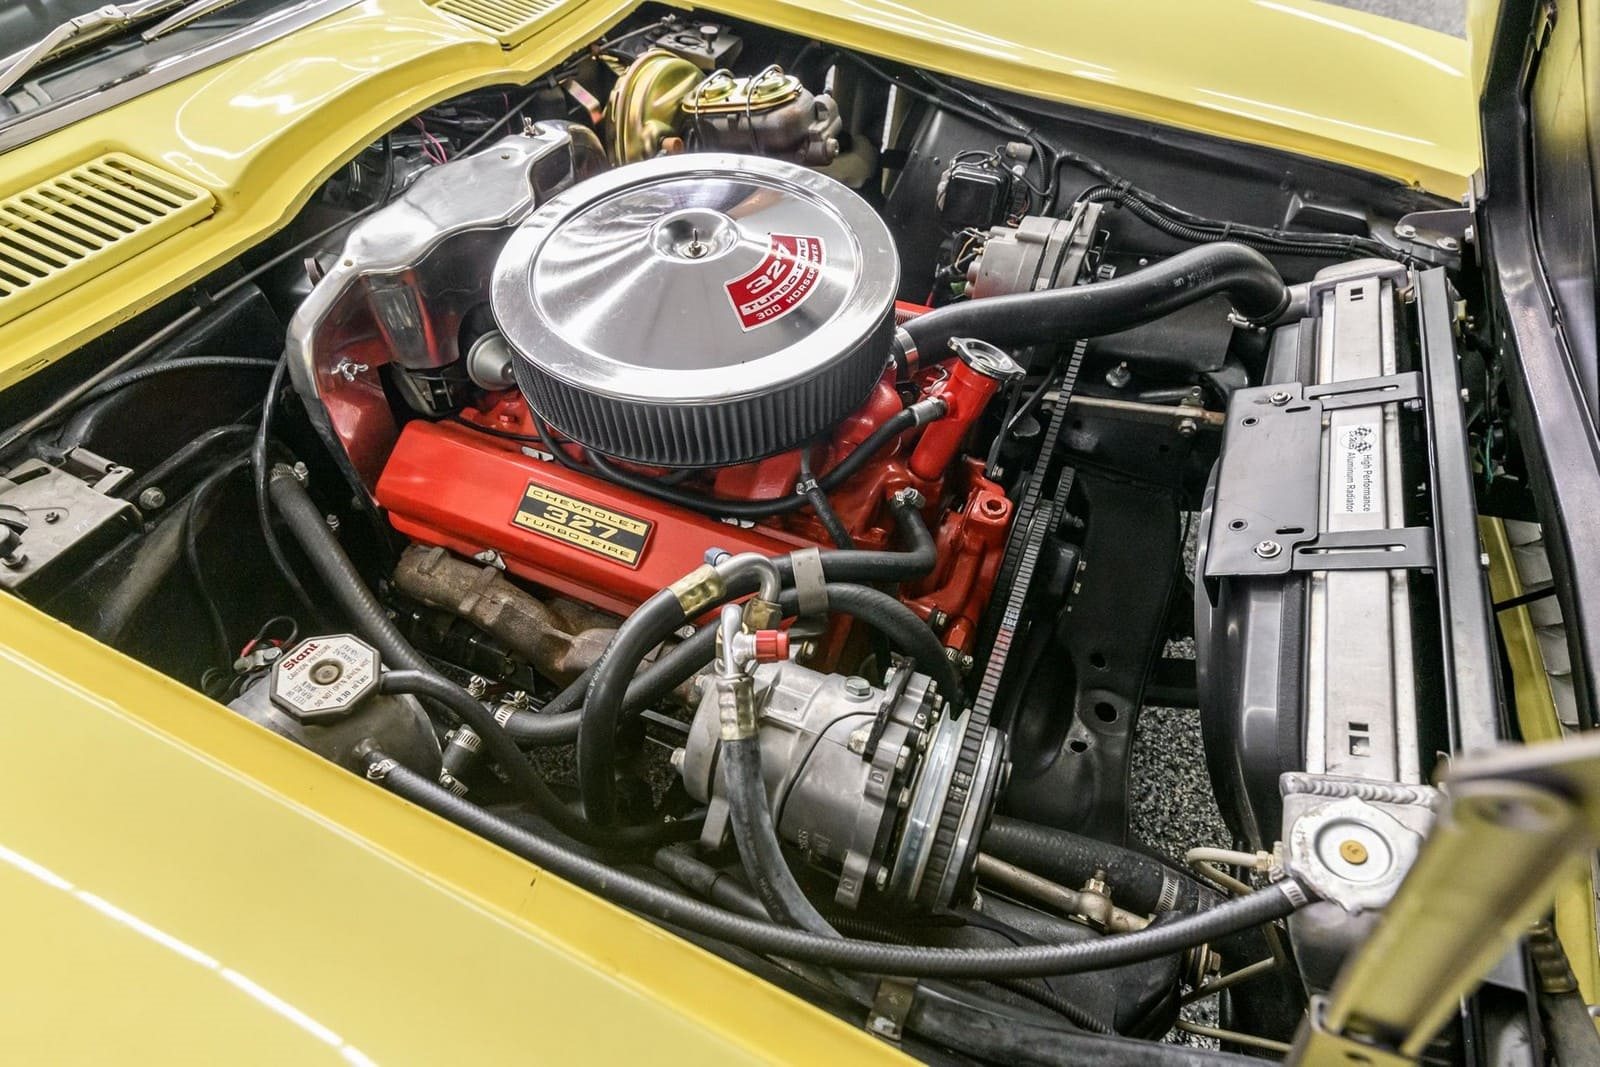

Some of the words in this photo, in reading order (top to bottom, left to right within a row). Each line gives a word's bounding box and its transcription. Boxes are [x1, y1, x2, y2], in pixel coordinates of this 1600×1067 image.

[745, 241, 806, 310] TURBO-FIRE
[746, 242, 796, 294] 327
[756, 304, 782, 319] 300
[786, 243, 819, 304] HORSEPWER
[1346, 452, 1355, 483] Aluminum
[1361, 454, 1372, 469] High
[533, 490, 640, 530] CHEVROLET
[1346, 484, 1356, 512] Radiator
[1362, 470, 1373, 512] Performance
[523, 515, 631, 558] TURBO-FIRE
[543, 505, 618, 539] 327
[283, 643, 318, 670] Stant
